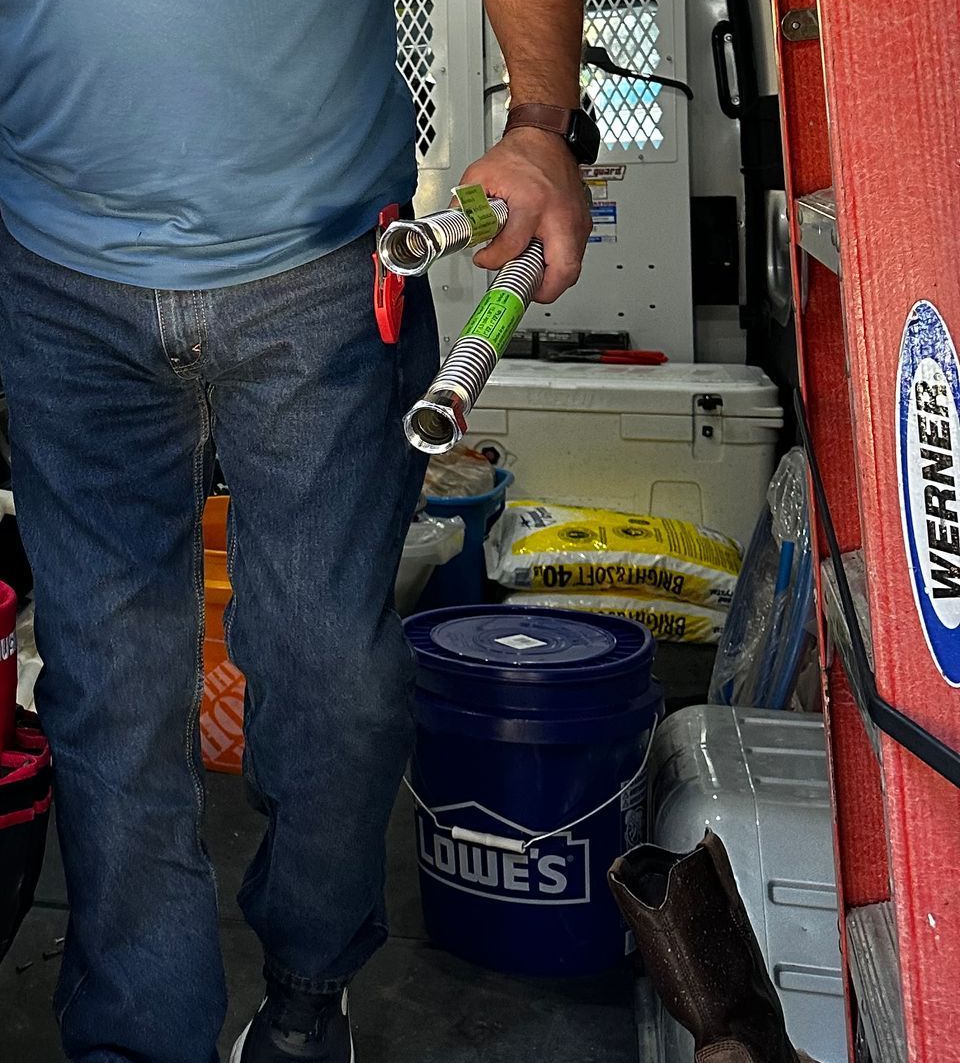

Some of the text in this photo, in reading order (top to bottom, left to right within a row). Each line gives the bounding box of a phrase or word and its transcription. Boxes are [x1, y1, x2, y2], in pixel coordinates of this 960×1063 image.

[915, 379, 960, 599] WERNER
[543, 565, 572, 587] 40
[418, 815, 568, 894] LOWE'S
